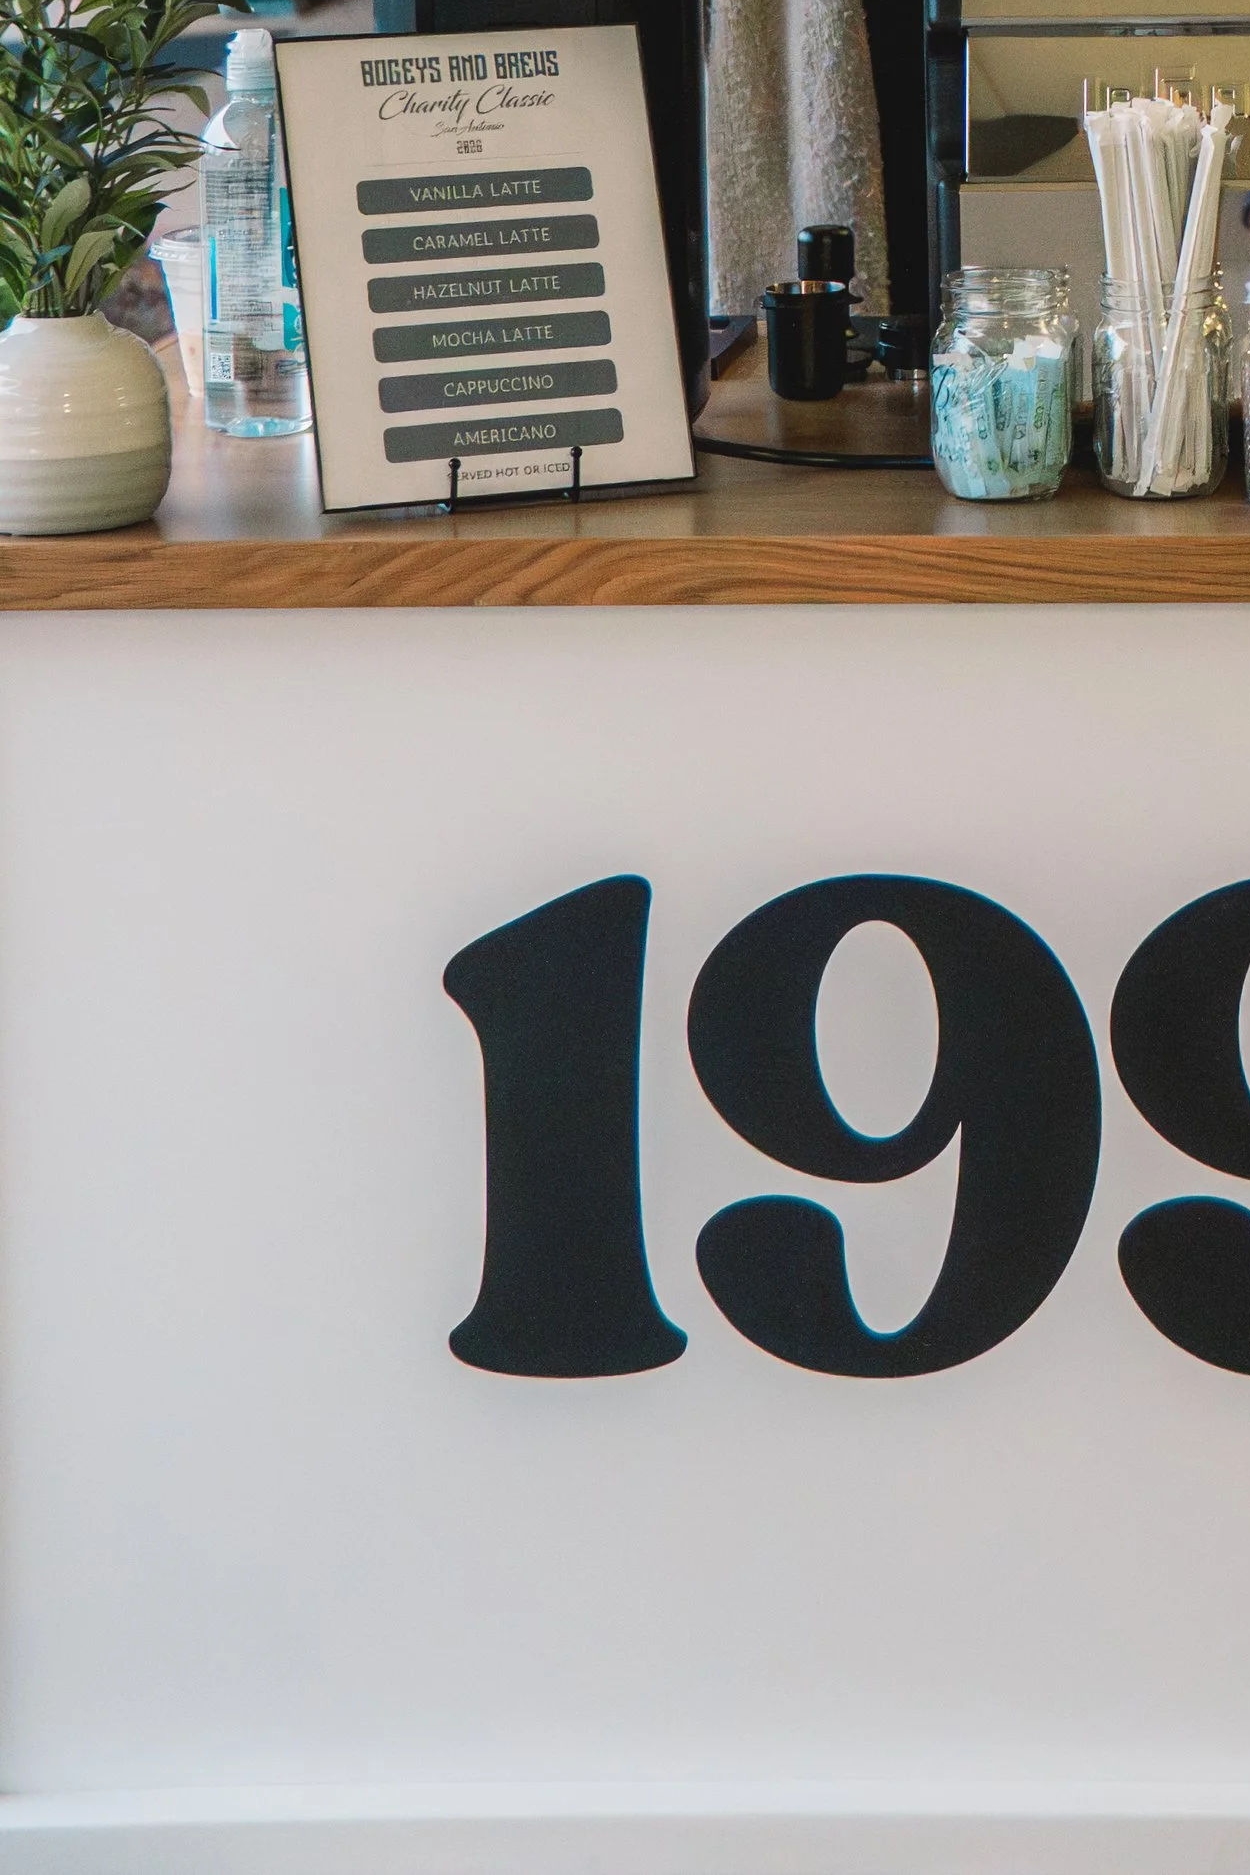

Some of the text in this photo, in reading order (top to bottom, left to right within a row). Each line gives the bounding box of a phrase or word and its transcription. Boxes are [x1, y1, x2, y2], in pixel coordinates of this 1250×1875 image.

[360, 50, 560, 87] BOGEYS AND BREWS
[378, 84, 555, 124] Charity Classic
[410, 180, 542, 202] VANILLA LATTE
[412, 227, 551, 251] CARAMEL LATTE
[413, 275, 561, 300] HAZELNUT LATTE
[432, 325, 554, 348] MOCHA LATTE
[443, 374, 554, 397] CAPPUCCINO
[453, 424, 557, 446] AMERICANO
[447, 462, 571, 481] RVED HOT OR ICED
